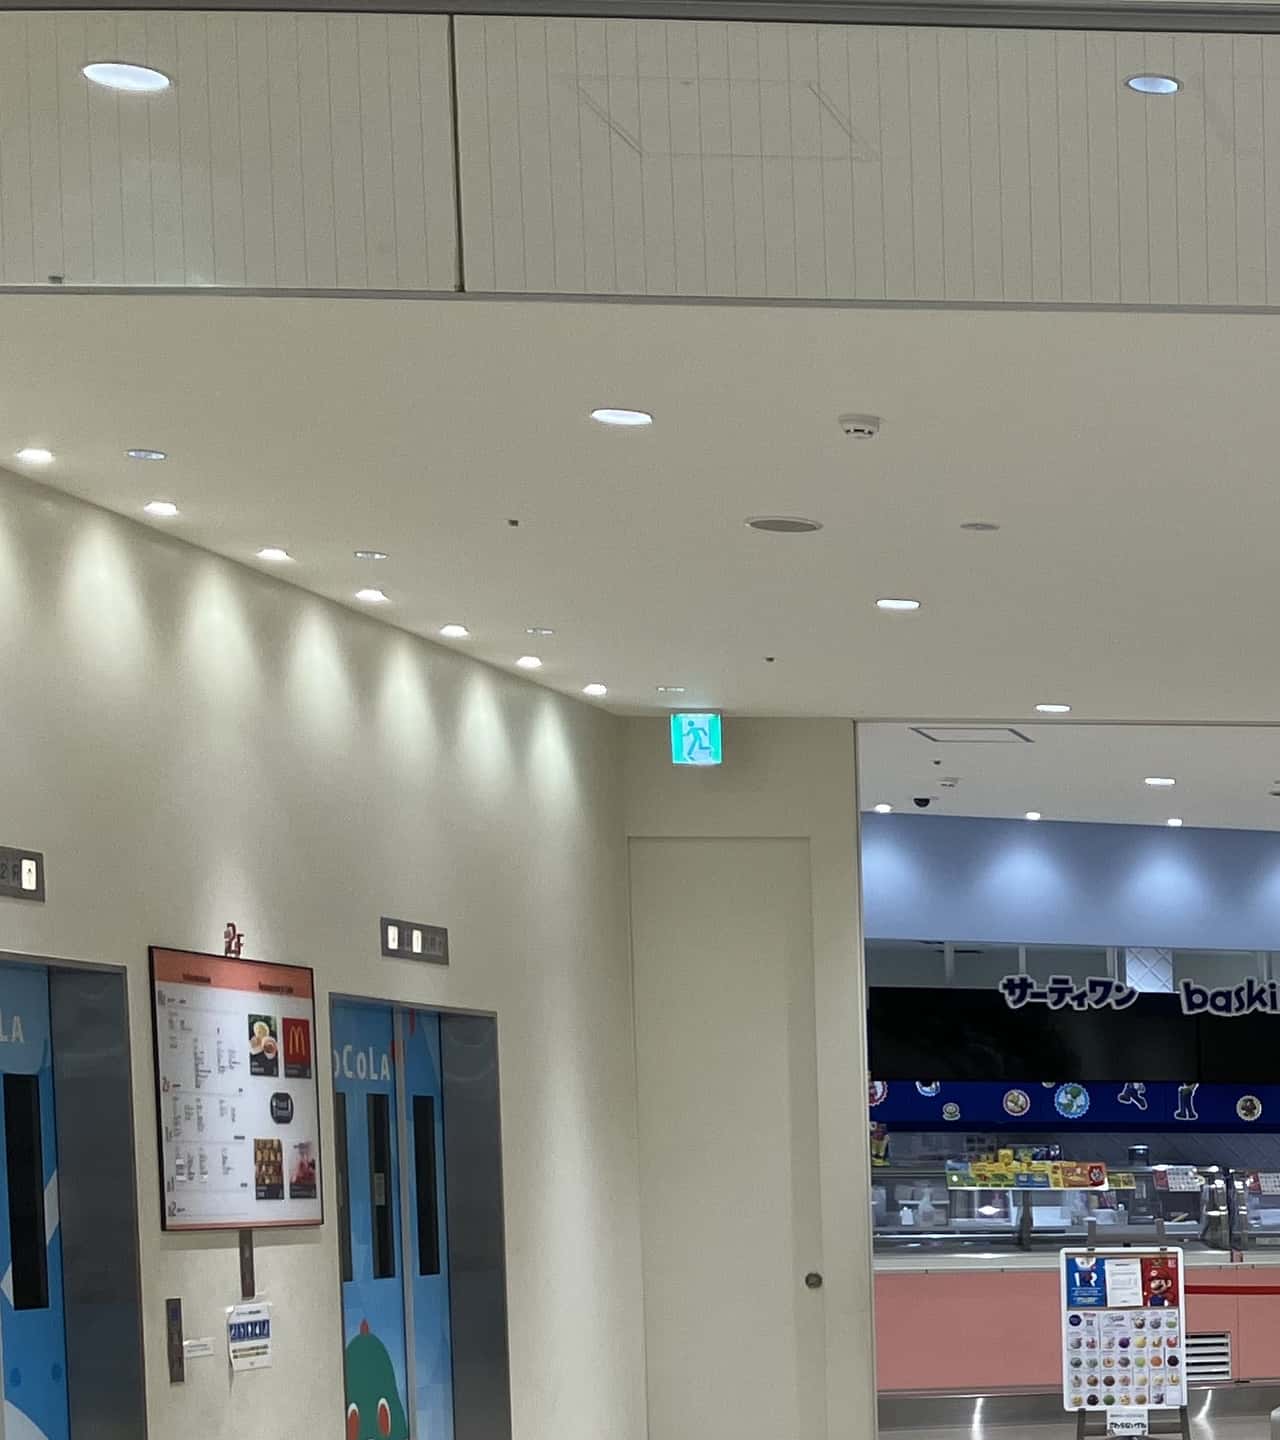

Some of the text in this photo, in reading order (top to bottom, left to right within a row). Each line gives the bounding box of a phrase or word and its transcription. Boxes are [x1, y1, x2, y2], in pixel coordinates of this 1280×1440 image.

[1002, 976, 1137, 1009] サーティワン
